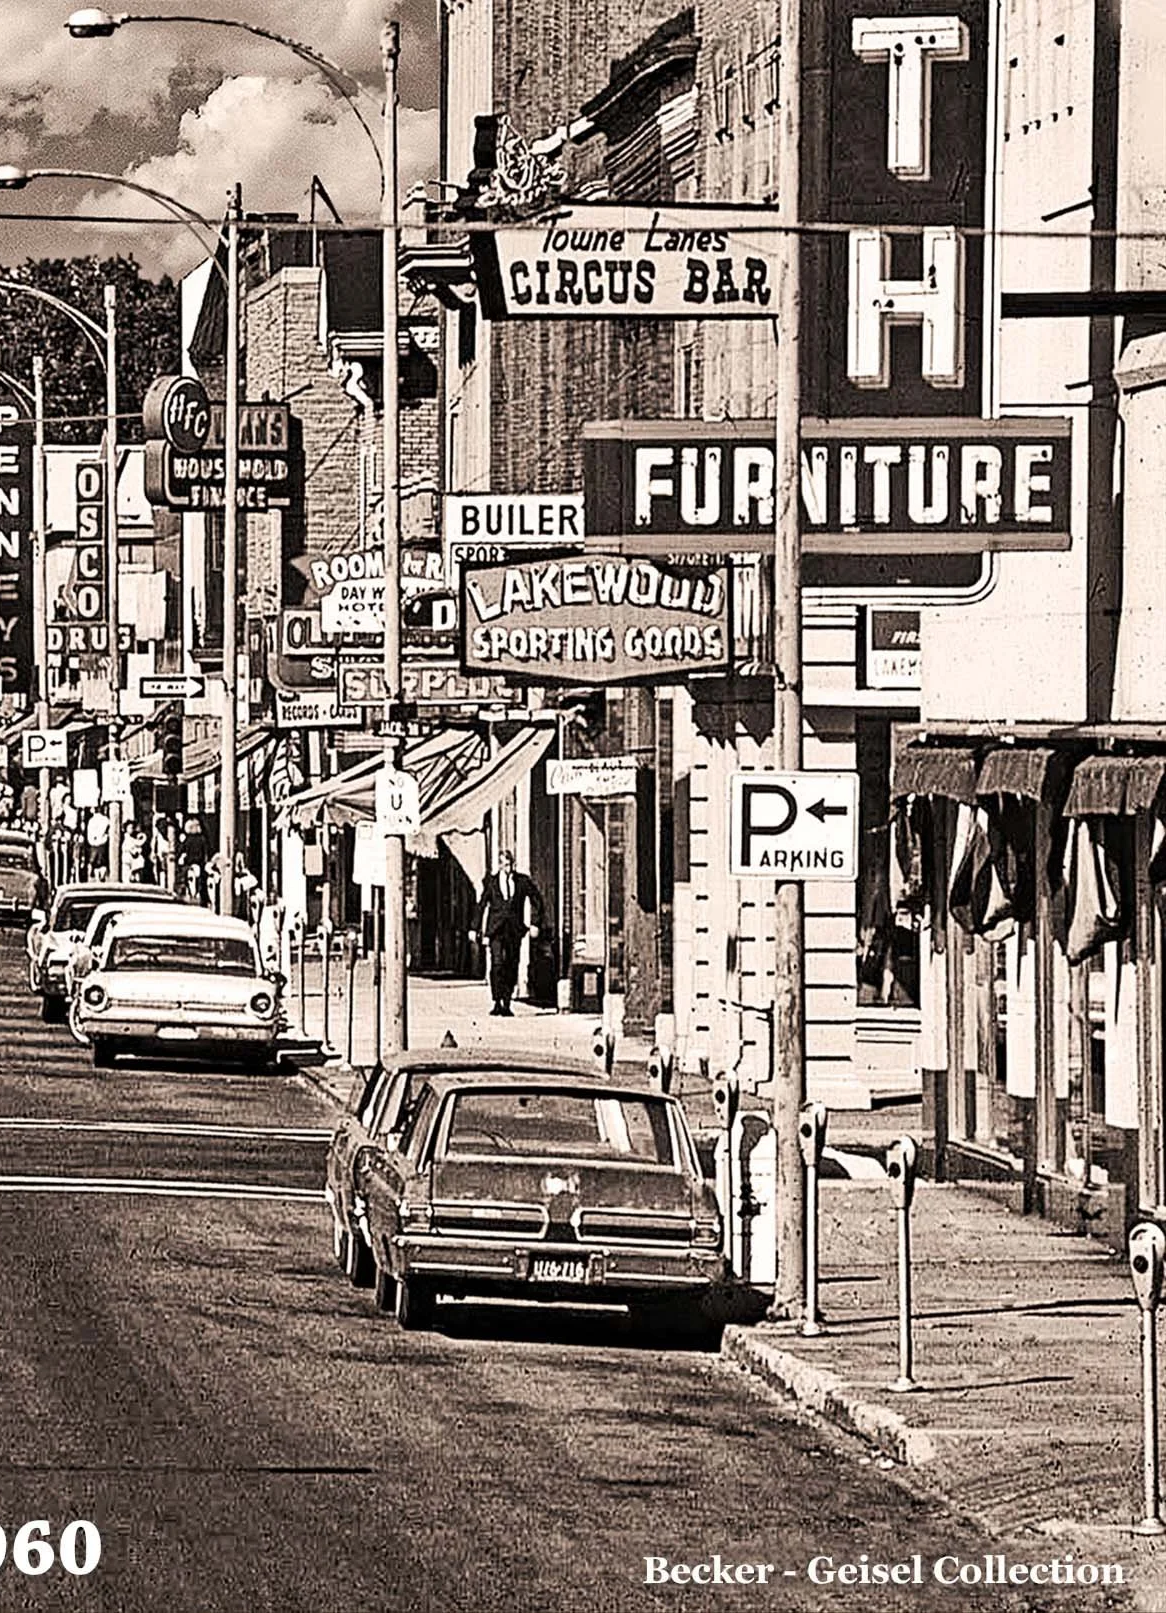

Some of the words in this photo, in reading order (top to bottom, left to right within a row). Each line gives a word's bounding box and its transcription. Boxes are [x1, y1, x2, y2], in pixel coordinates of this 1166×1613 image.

[538, 211, 624, 253] Towne
[645, 211, 729, 253] Lanes
[510, 259, 656, 305] CIRCUS
[684, 257, 772, 306] BAR
[170, 393, 207, 438] HFC
[213, 411, 283, 446] LANS
[173, 457, 288, 481] HOUSHOLD
[634, 445, 1054, 527] FURNITURE
[190, 486, 267, 508] FINNCE
[461, 503, 579, 536] BUILER
[79, 467, 100, 618] OSCO
[310, 550, 386, 589] ROOM
[341, 587, 366, 600] DAY
[47, 634, 131, 651] DRUG
[472, 626, 615, 661] SPORTING
[624, 625, 723, 660] GOODS
[741, 783, 845, 872] PARKING
